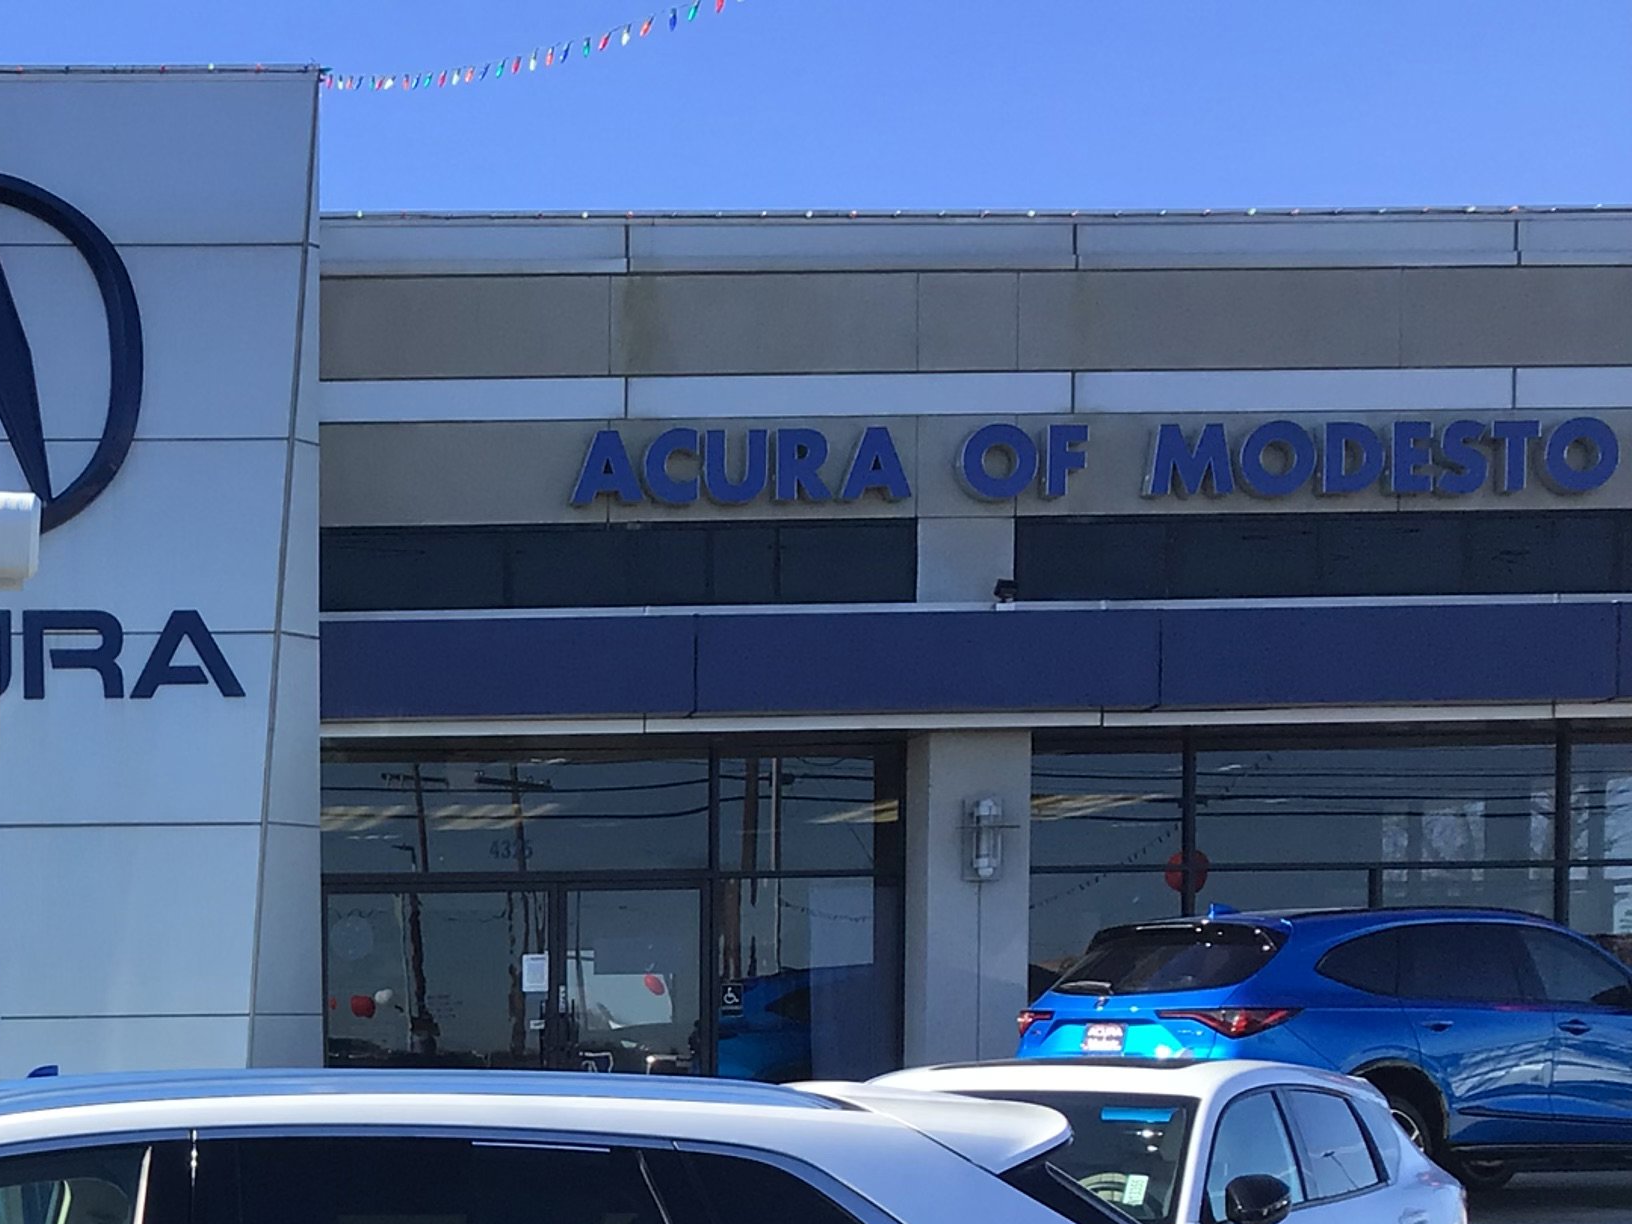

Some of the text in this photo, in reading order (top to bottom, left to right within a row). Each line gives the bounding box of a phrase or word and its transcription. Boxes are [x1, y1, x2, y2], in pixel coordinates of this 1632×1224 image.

[570, 416, 1620, 504] ACURA OF MODESTO
